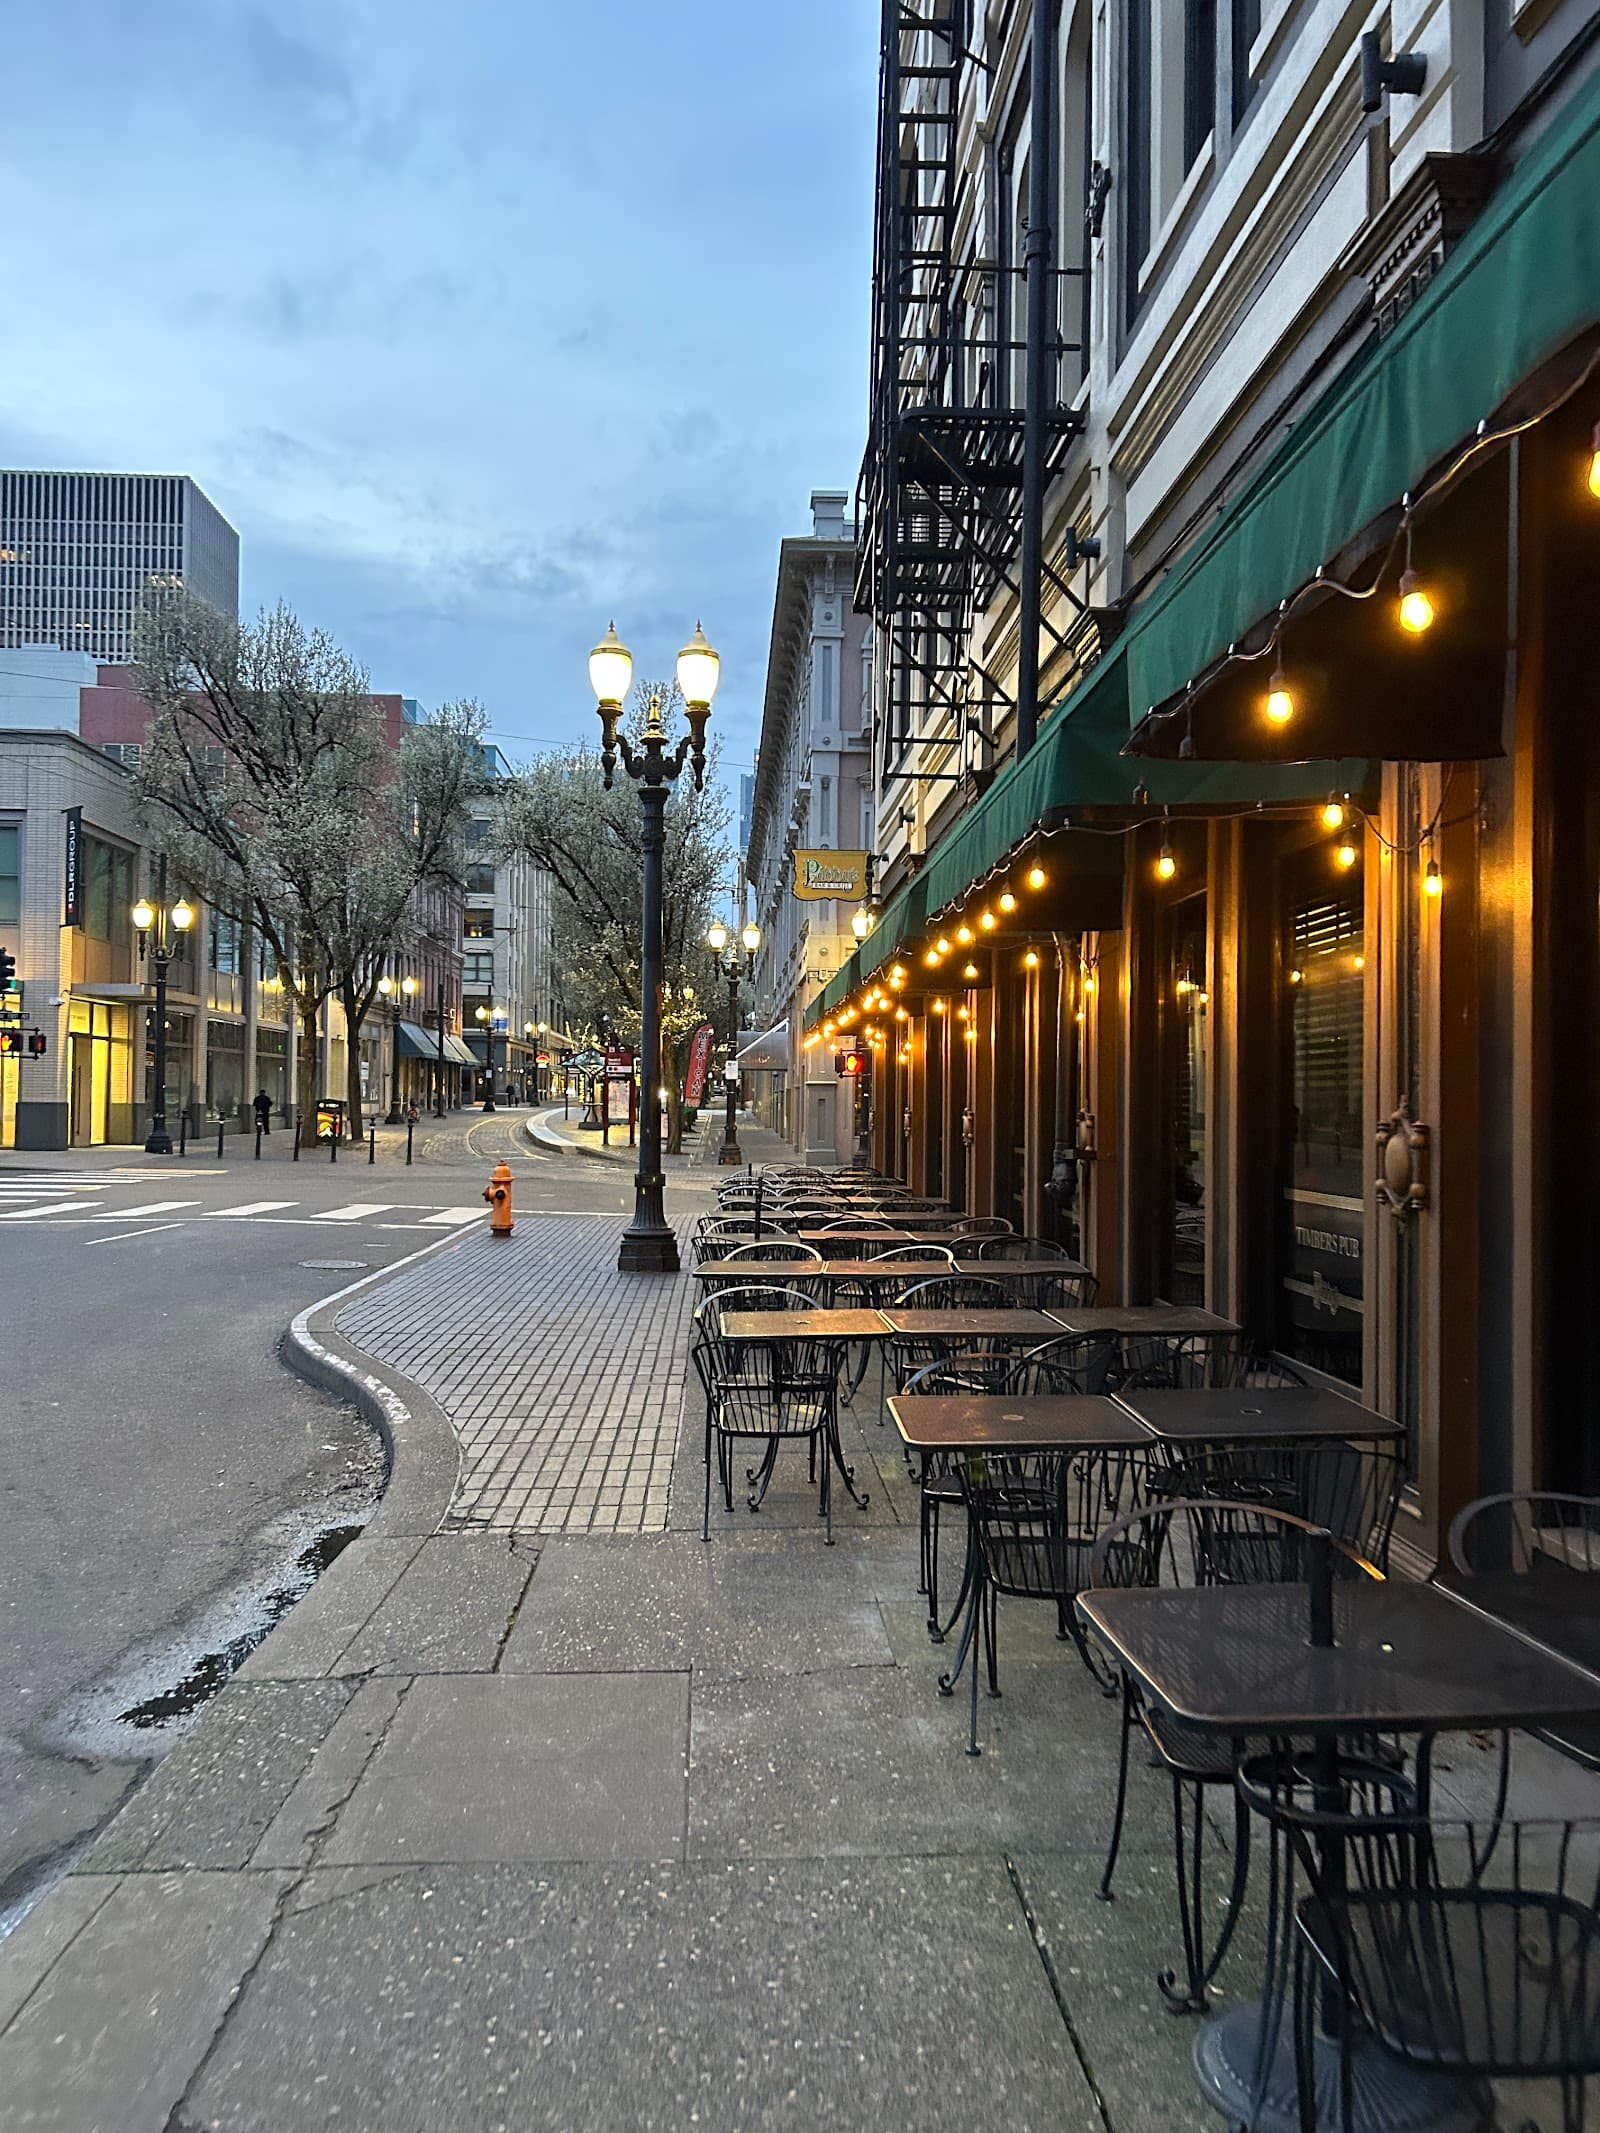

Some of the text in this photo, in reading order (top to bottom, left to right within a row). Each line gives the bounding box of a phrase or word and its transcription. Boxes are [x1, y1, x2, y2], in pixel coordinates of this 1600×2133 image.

[691, 1031, 708, 1096] MEXICAN
[1295, 1226, 1360, 1258] TIMBERS PUB
